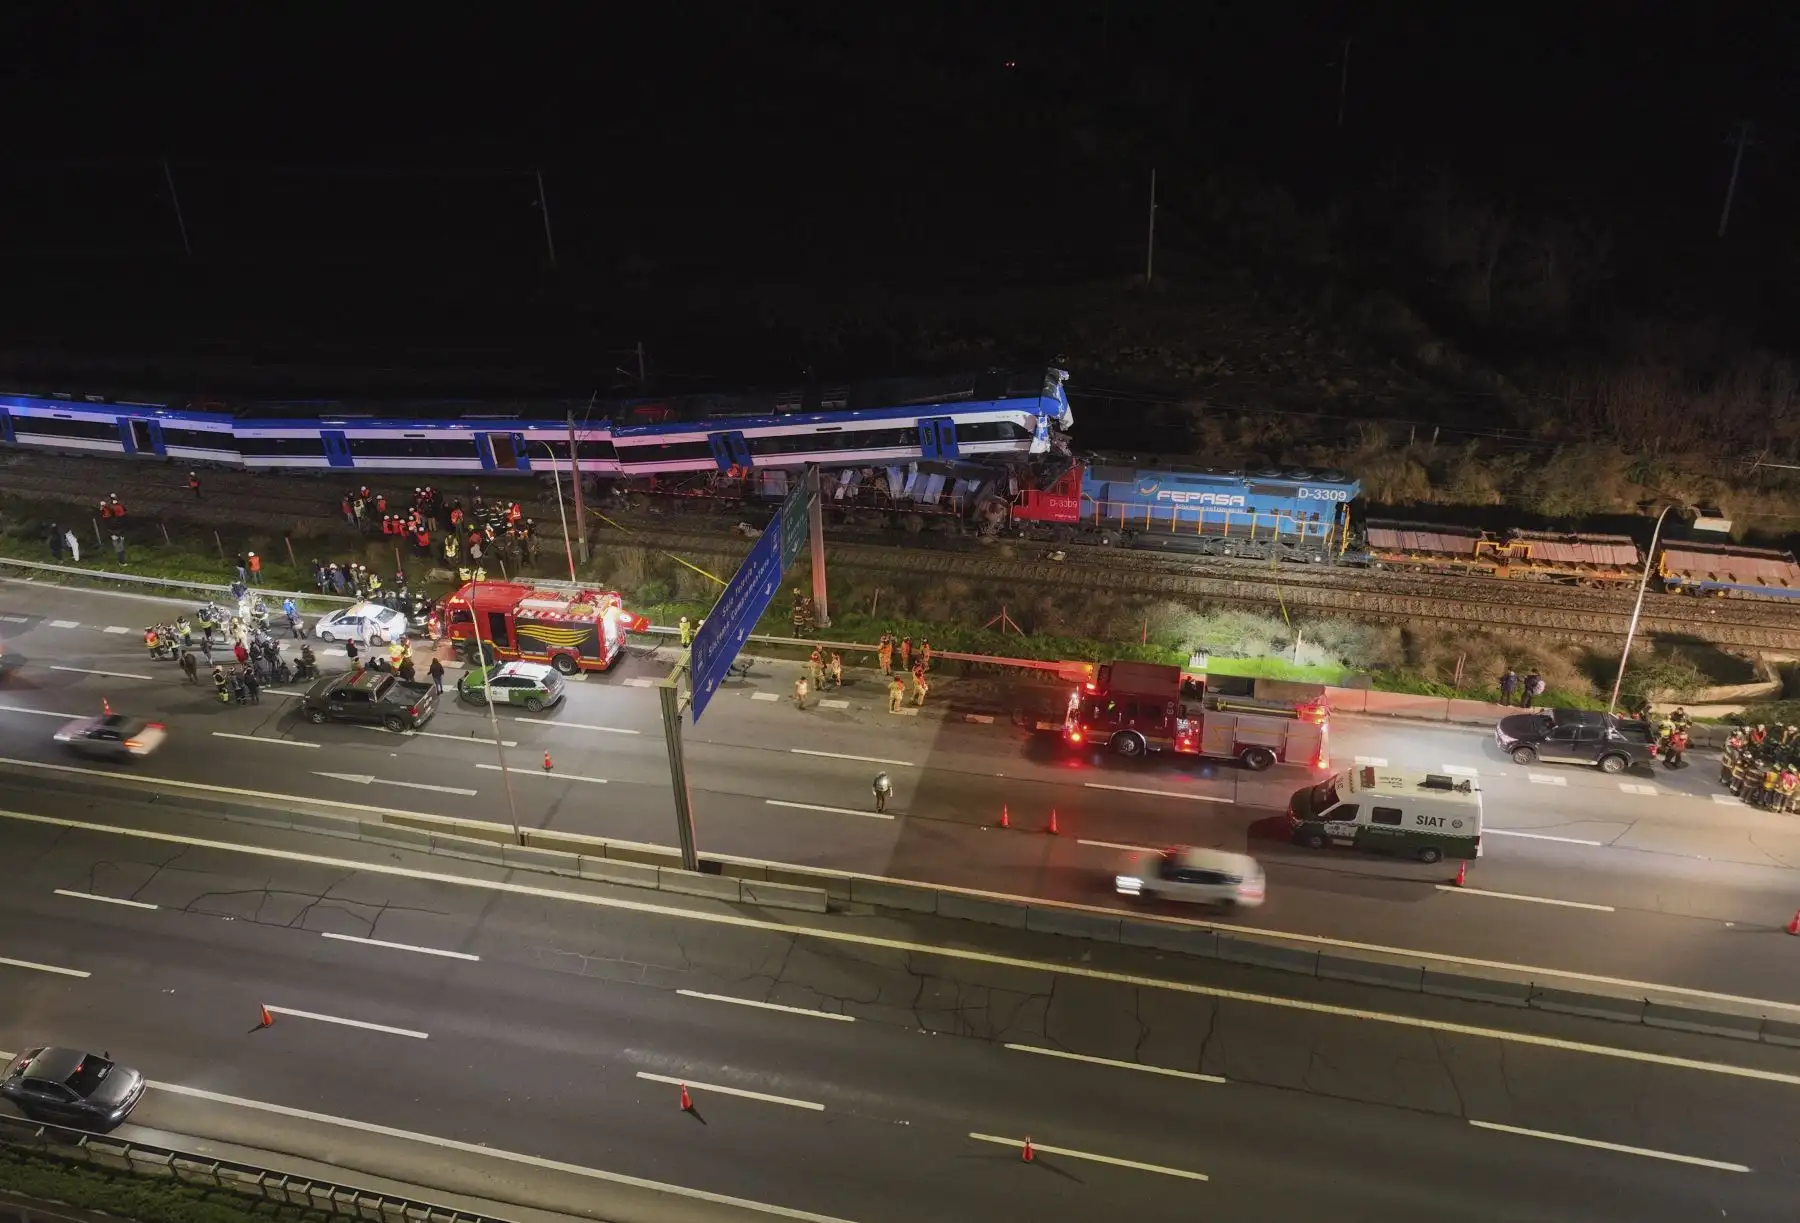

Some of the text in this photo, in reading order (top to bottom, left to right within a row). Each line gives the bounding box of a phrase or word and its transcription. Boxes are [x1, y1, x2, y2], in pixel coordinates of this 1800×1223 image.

[1157, 490, 1245, 507] FEPASA
[1298, 487, 1347, 501] D-3309
[1416, 815, 1446, 828] SIAT
